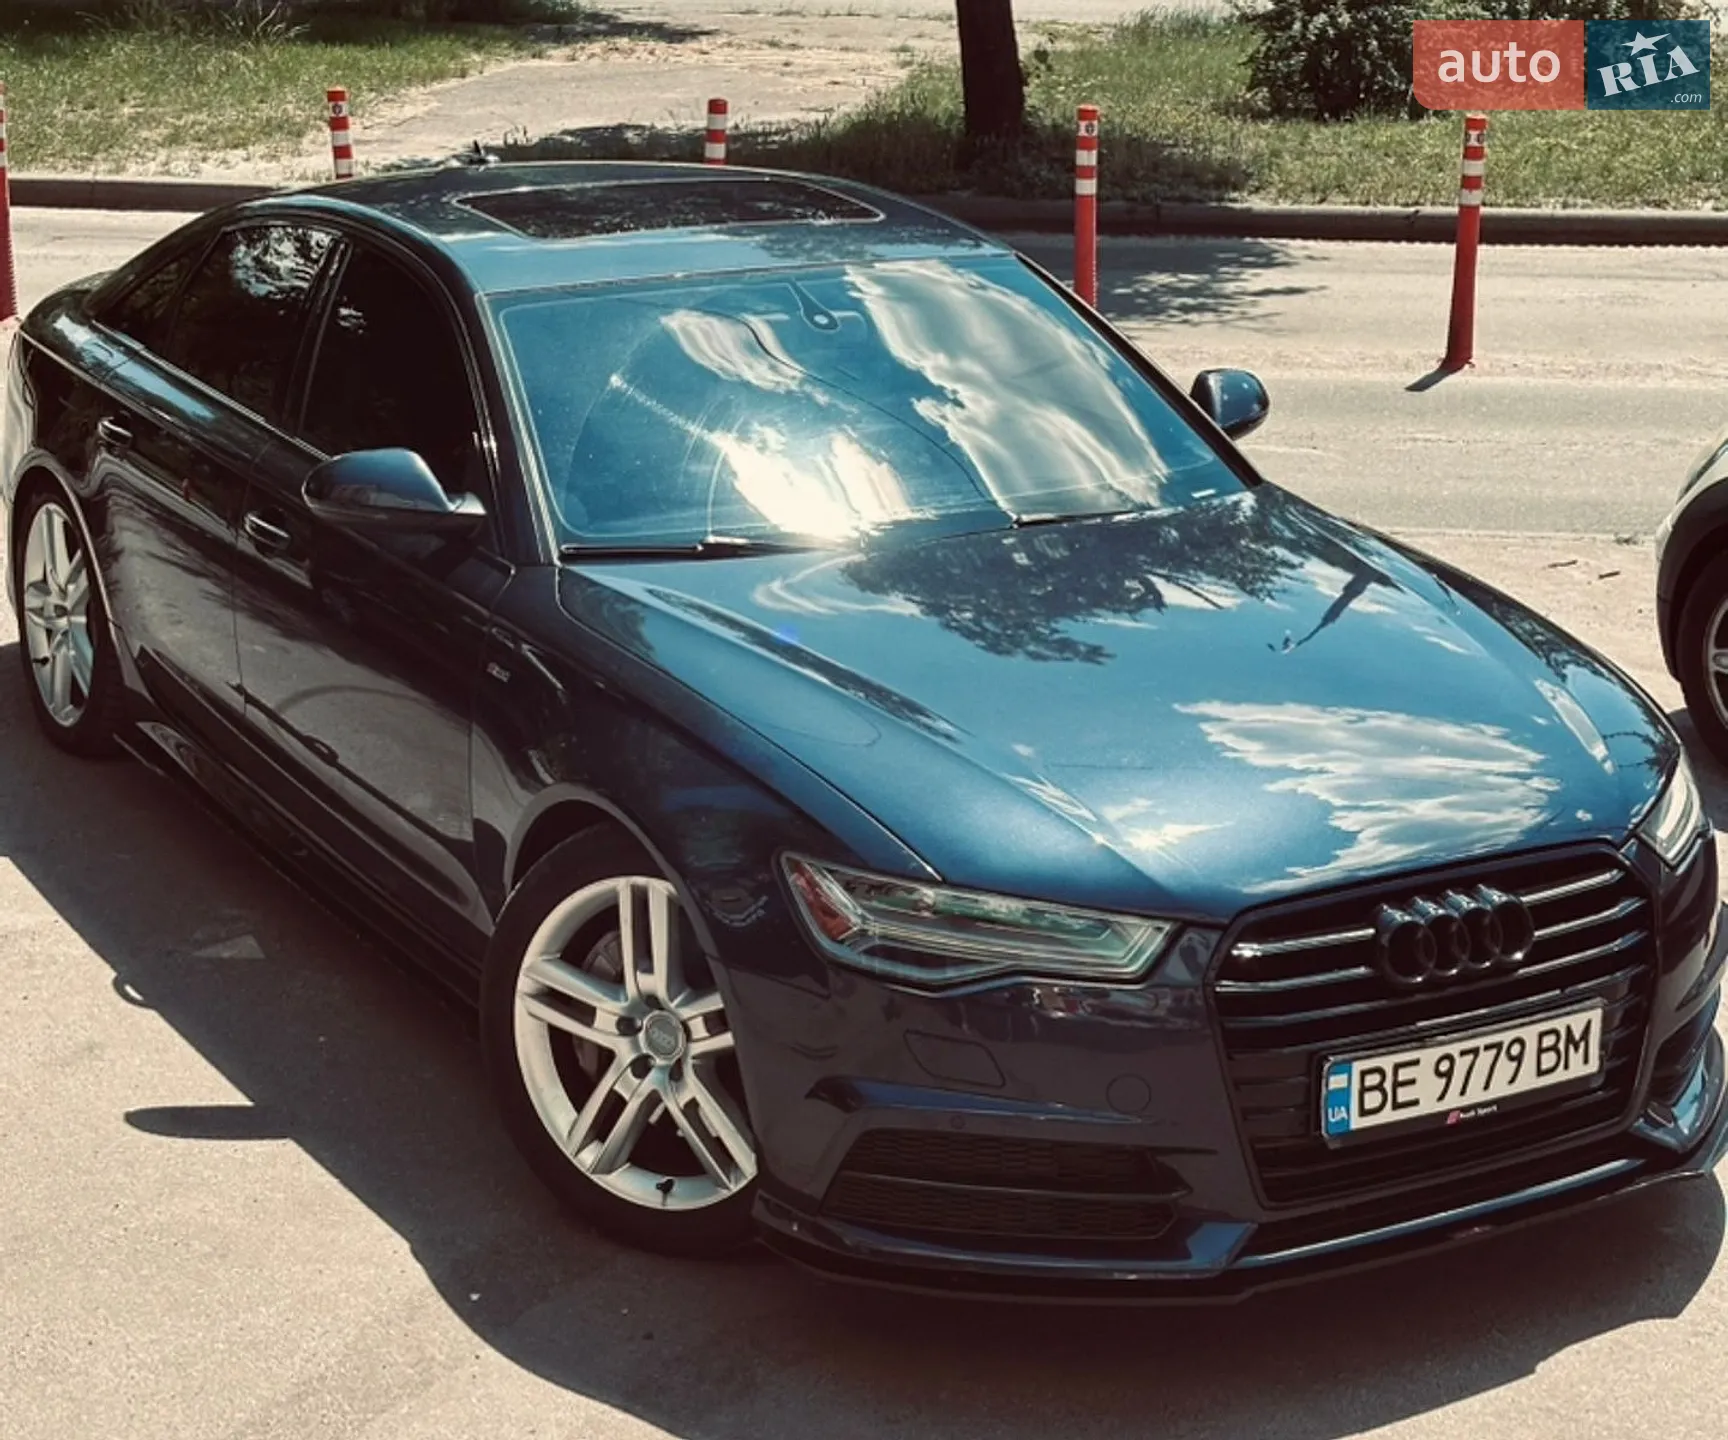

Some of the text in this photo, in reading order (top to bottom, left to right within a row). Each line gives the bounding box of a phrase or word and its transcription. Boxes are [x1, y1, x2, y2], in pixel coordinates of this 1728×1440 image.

[1357, 1018, 1593, 1118] BE 9779 BM
[1327, 1105, 1348, 1122] UA
